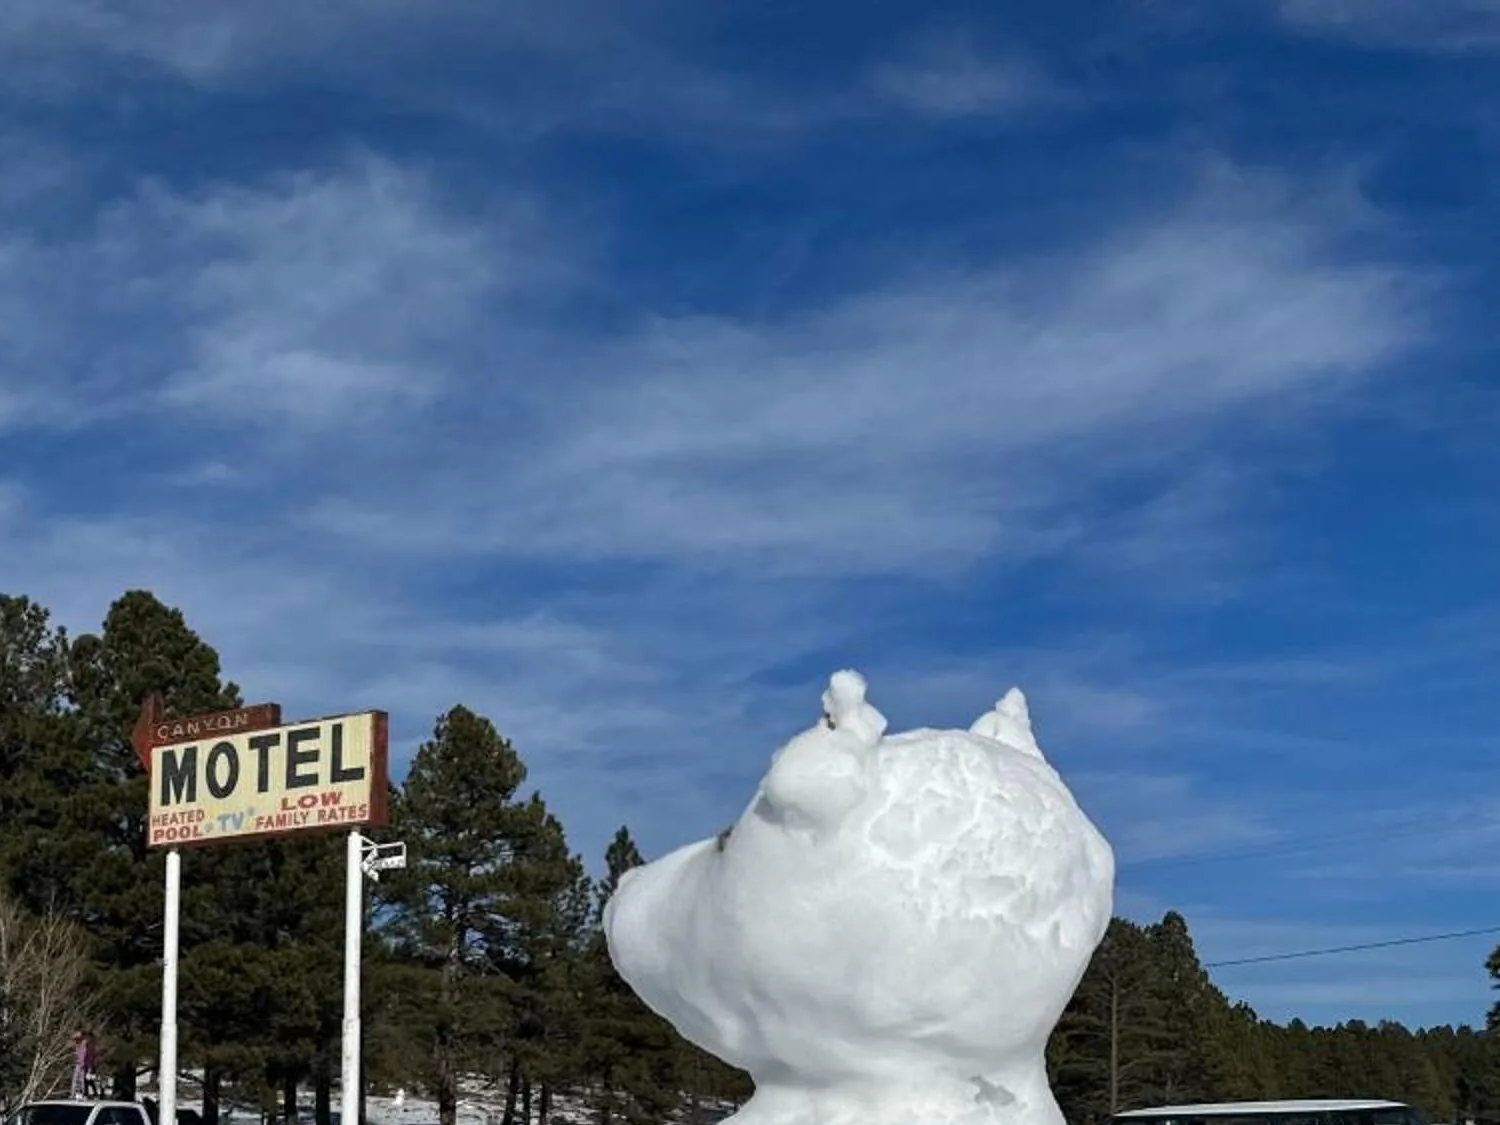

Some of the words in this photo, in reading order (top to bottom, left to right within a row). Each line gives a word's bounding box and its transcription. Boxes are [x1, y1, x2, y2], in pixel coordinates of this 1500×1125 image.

[157, 712, 249, 740] CANYON
[160, 722, 365, 806] MOTEL
[281, 791, 342, 810] LOW
[151, 808, 205, 827] HEATED
[217, 812, 244, 832] TV
[255, 811, 309, 830] FAMILY
[318, 804, 367, 822] RATES
[153, 825, 204, 842] POOL
